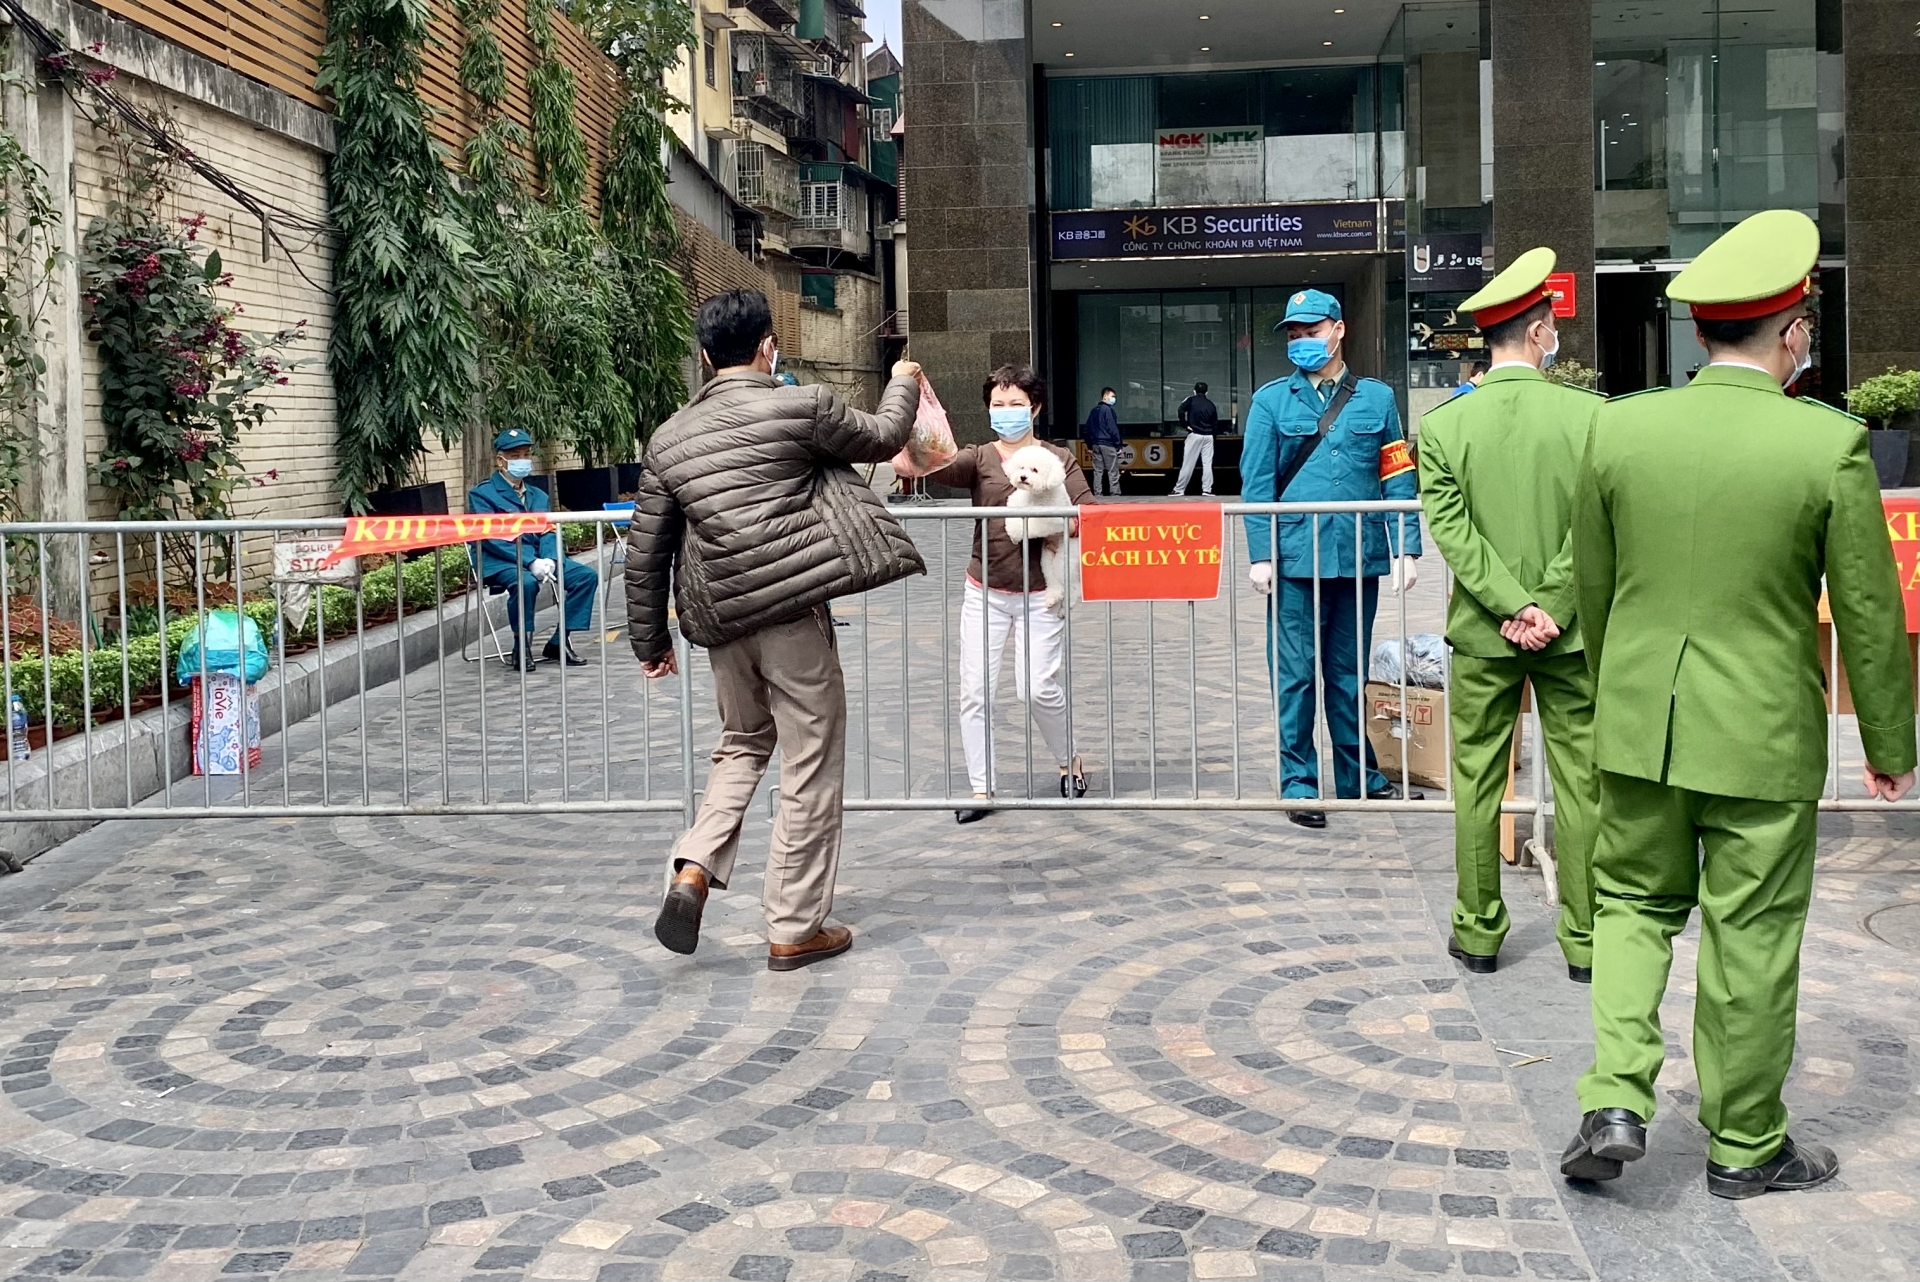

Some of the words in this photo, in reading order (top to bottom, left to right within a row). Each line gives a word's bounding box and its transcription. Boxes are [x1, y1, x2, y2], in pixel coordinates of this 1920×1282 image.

[1160, 133, 1204, 149] NGK
[1212, 130, 1258, 147] NTK
[1163, 216, 1197, 234] KB
[1204, 214, 1302, 234] Securities
[1333, 219, 1372, 228] Vietnam
[1316, 230, 1372, 238] www.kbsec.com.vn
[1123, 241, 1148, 252] CÔNG
[1152, 242, 1164, 250] TY
[1168, 240, 1201, 250] CHỨNG
[1206, 238, 1238, 248] KHOÁN
[1242, 239, 1254, 248] KB
[1258, 237, 1278, 248] VIỆT
[1280, 238, 1302, 247] NAM
[1467, 256, 1482, 266] US
[1150, 446, 1160, 462] 5
[352, 518, 444, 542] KHU
[1106, 525, 1152, 542] KHU
[1156, 522, 1202, 544] VỰC
[1082, 546, 1140, 566] CÁCH
[1146, 550, 1172, 566] LY
[1176, 550, 1190, 565] Y
[1194, 544, 1220, 565] TẾ
[214, 688, 227, 720] laVie
